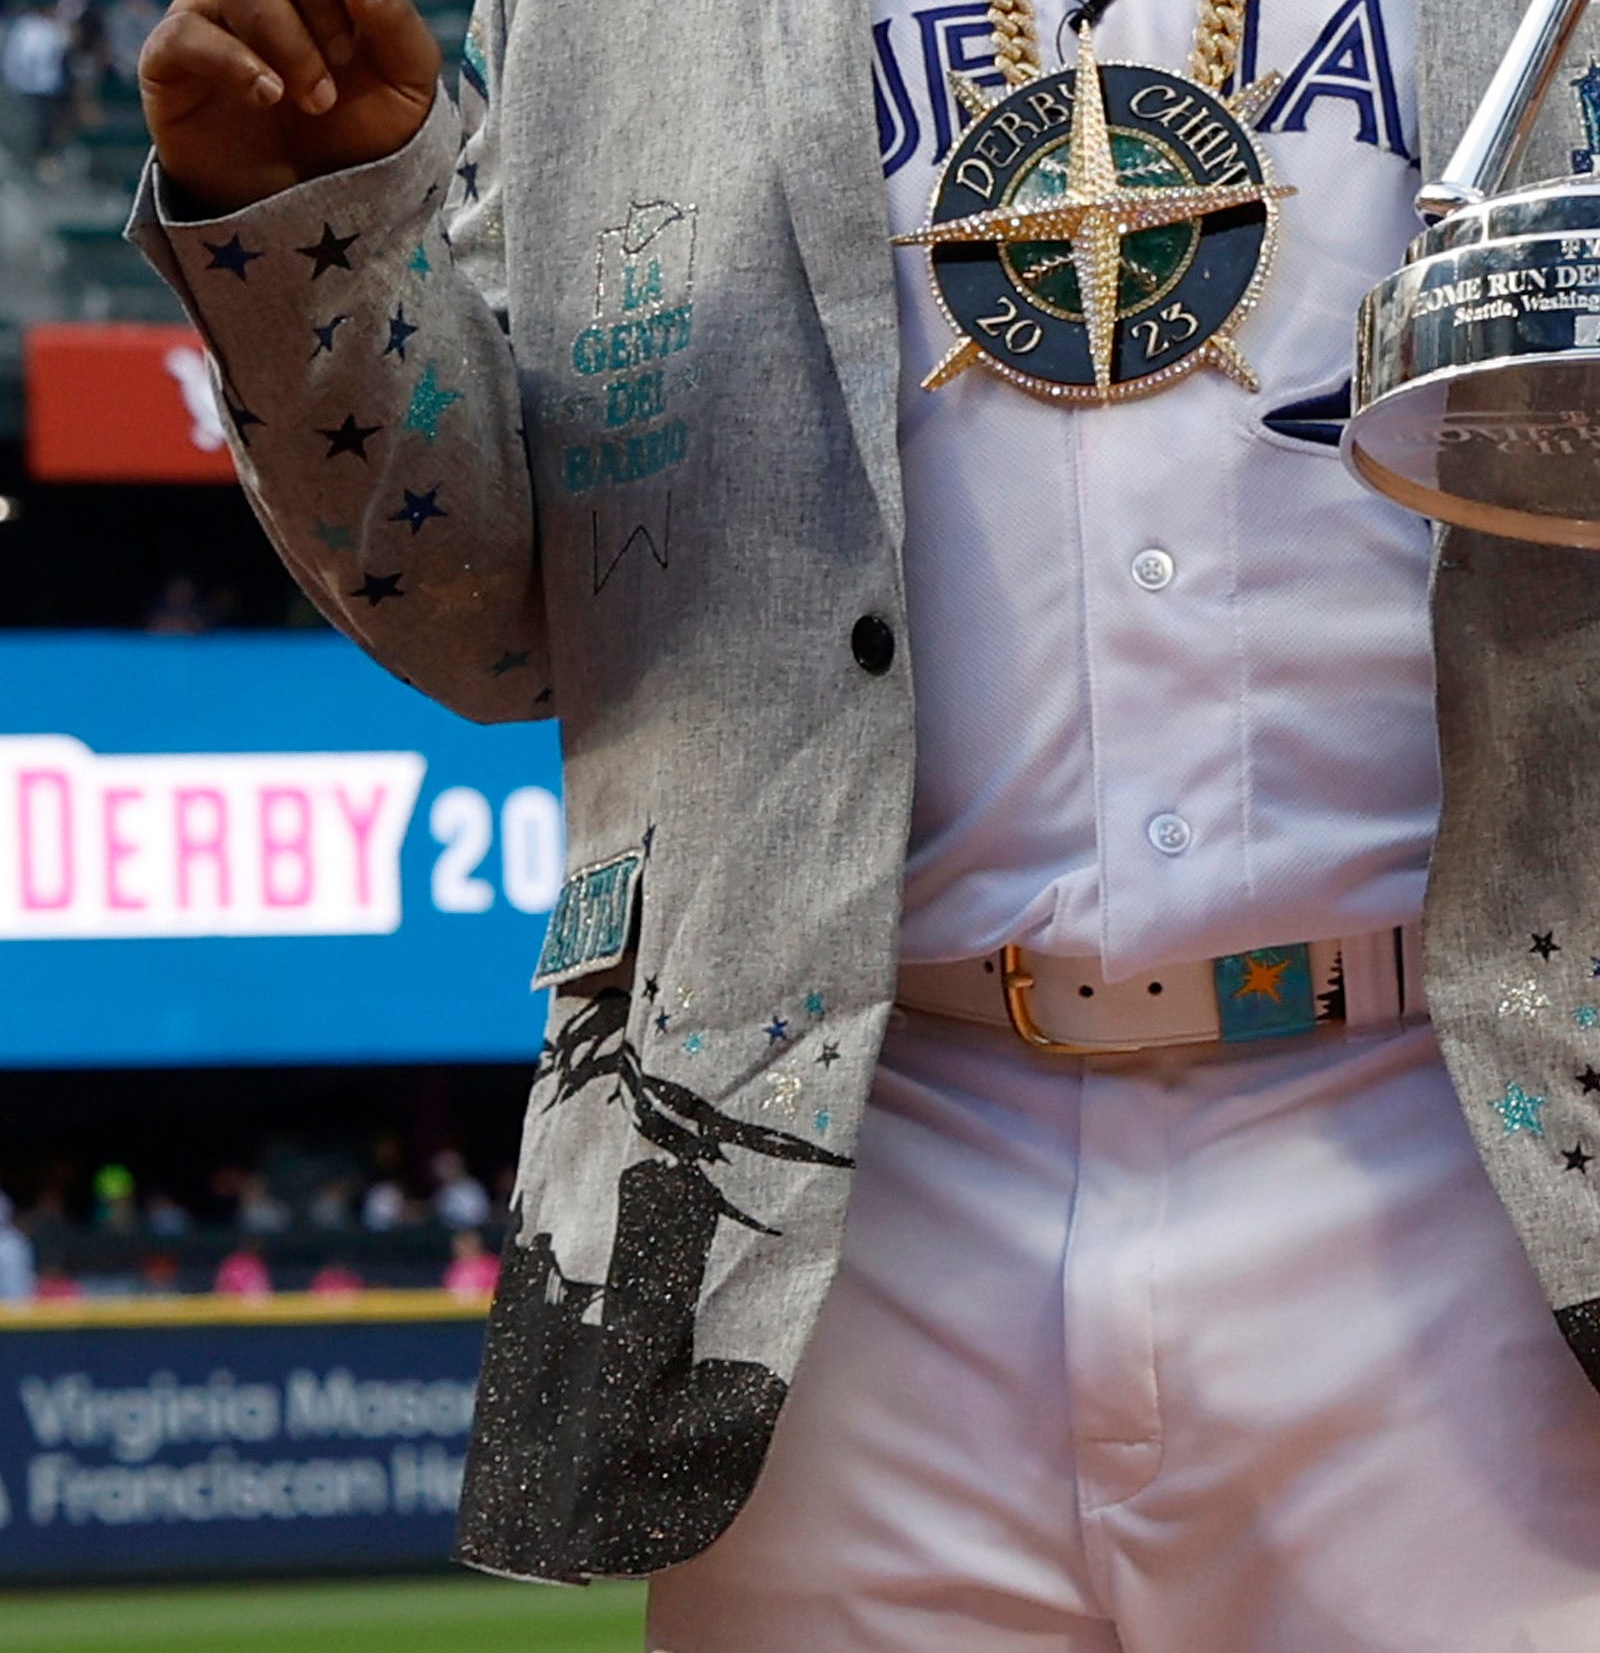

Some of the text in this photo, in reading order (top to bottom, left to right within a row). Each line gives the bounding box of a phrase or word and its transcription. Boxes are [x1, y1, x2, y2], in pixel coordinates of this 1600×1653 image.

[622, 255, 663, 312] LA
[1486, 266, 1549, 297] RUN
[976, 295, 1200, 359] 20 23
[18, 1370, 284, 1462] Virginia
[26, 1446, 392, 1528] Franciscan
